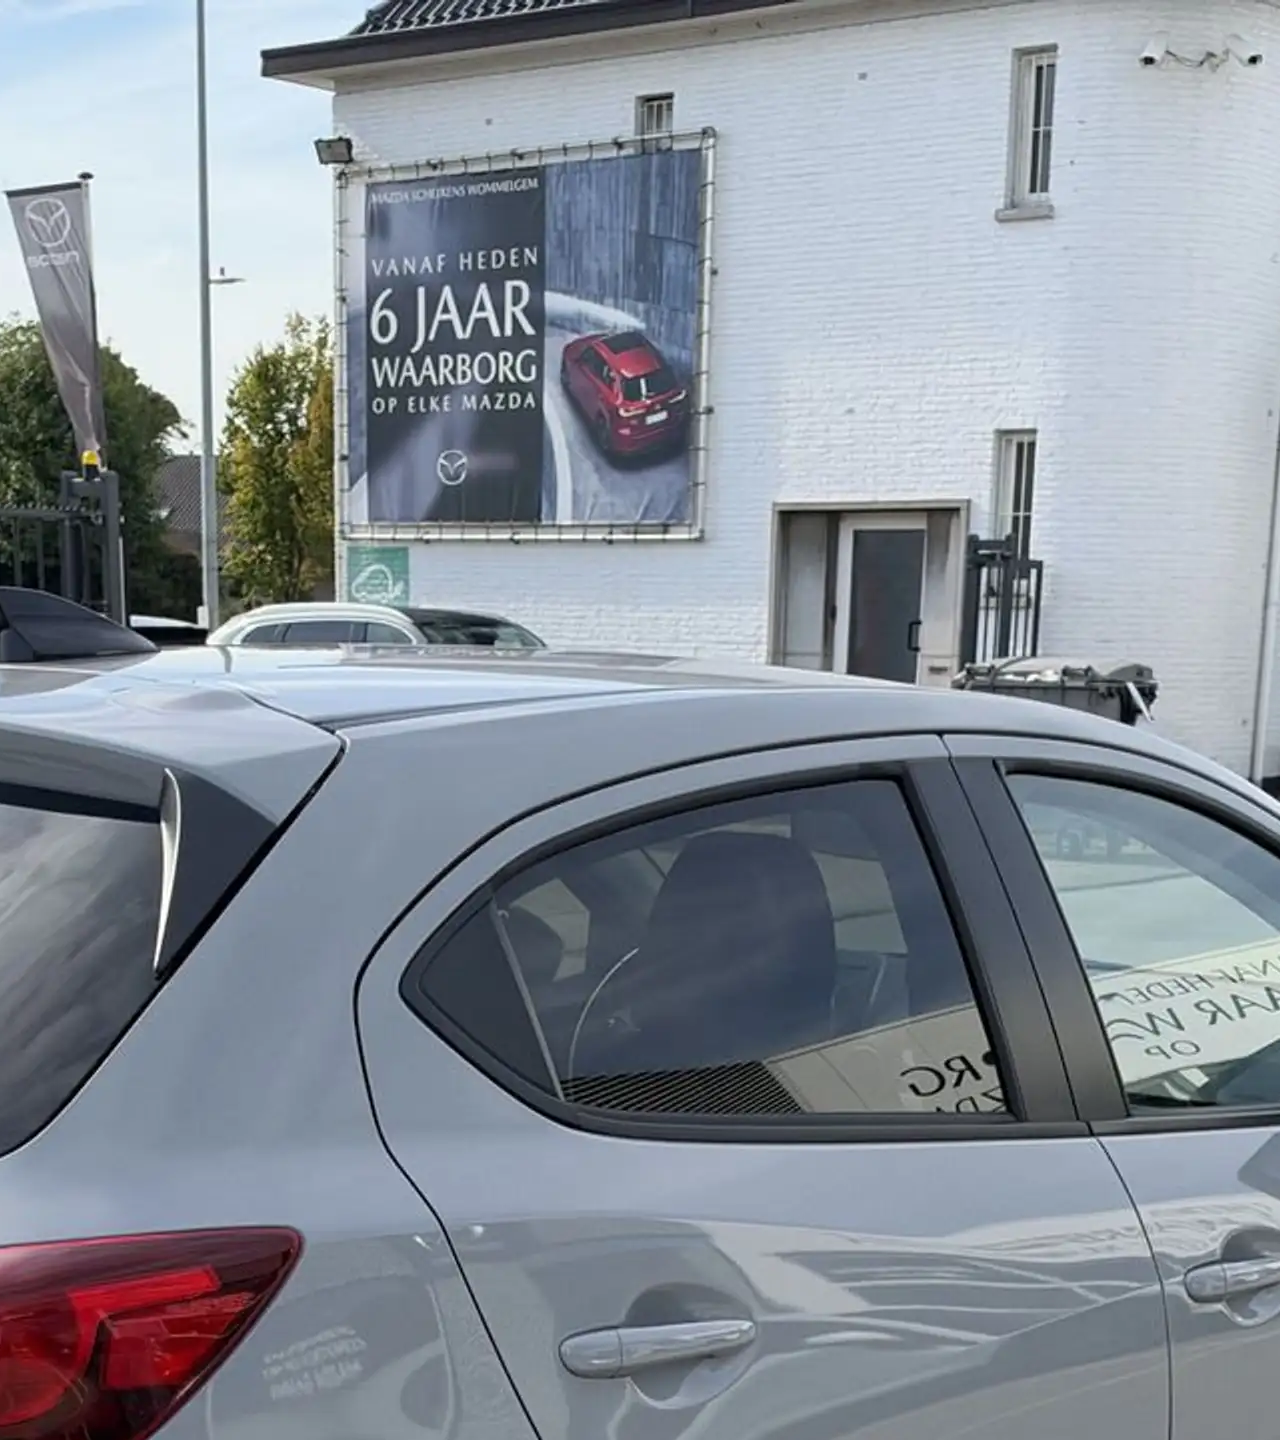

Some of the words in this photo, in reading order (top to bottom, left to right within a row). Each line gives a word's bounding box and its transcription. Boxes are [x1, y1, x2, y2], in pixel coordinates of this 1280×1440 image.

[372, 254, 446, 277] VANAF
[459, 246, 538, 271] HEDEN
[370, 288, 398, 345] 6
[410, 280, 536, 353] JAAR
[371, 349, 537, 388] WAARBORG
[372, 396, 397, 415] OP
[407, 394, 451, 413] ELKE
[461, 391, 536, 412] MAZDA
